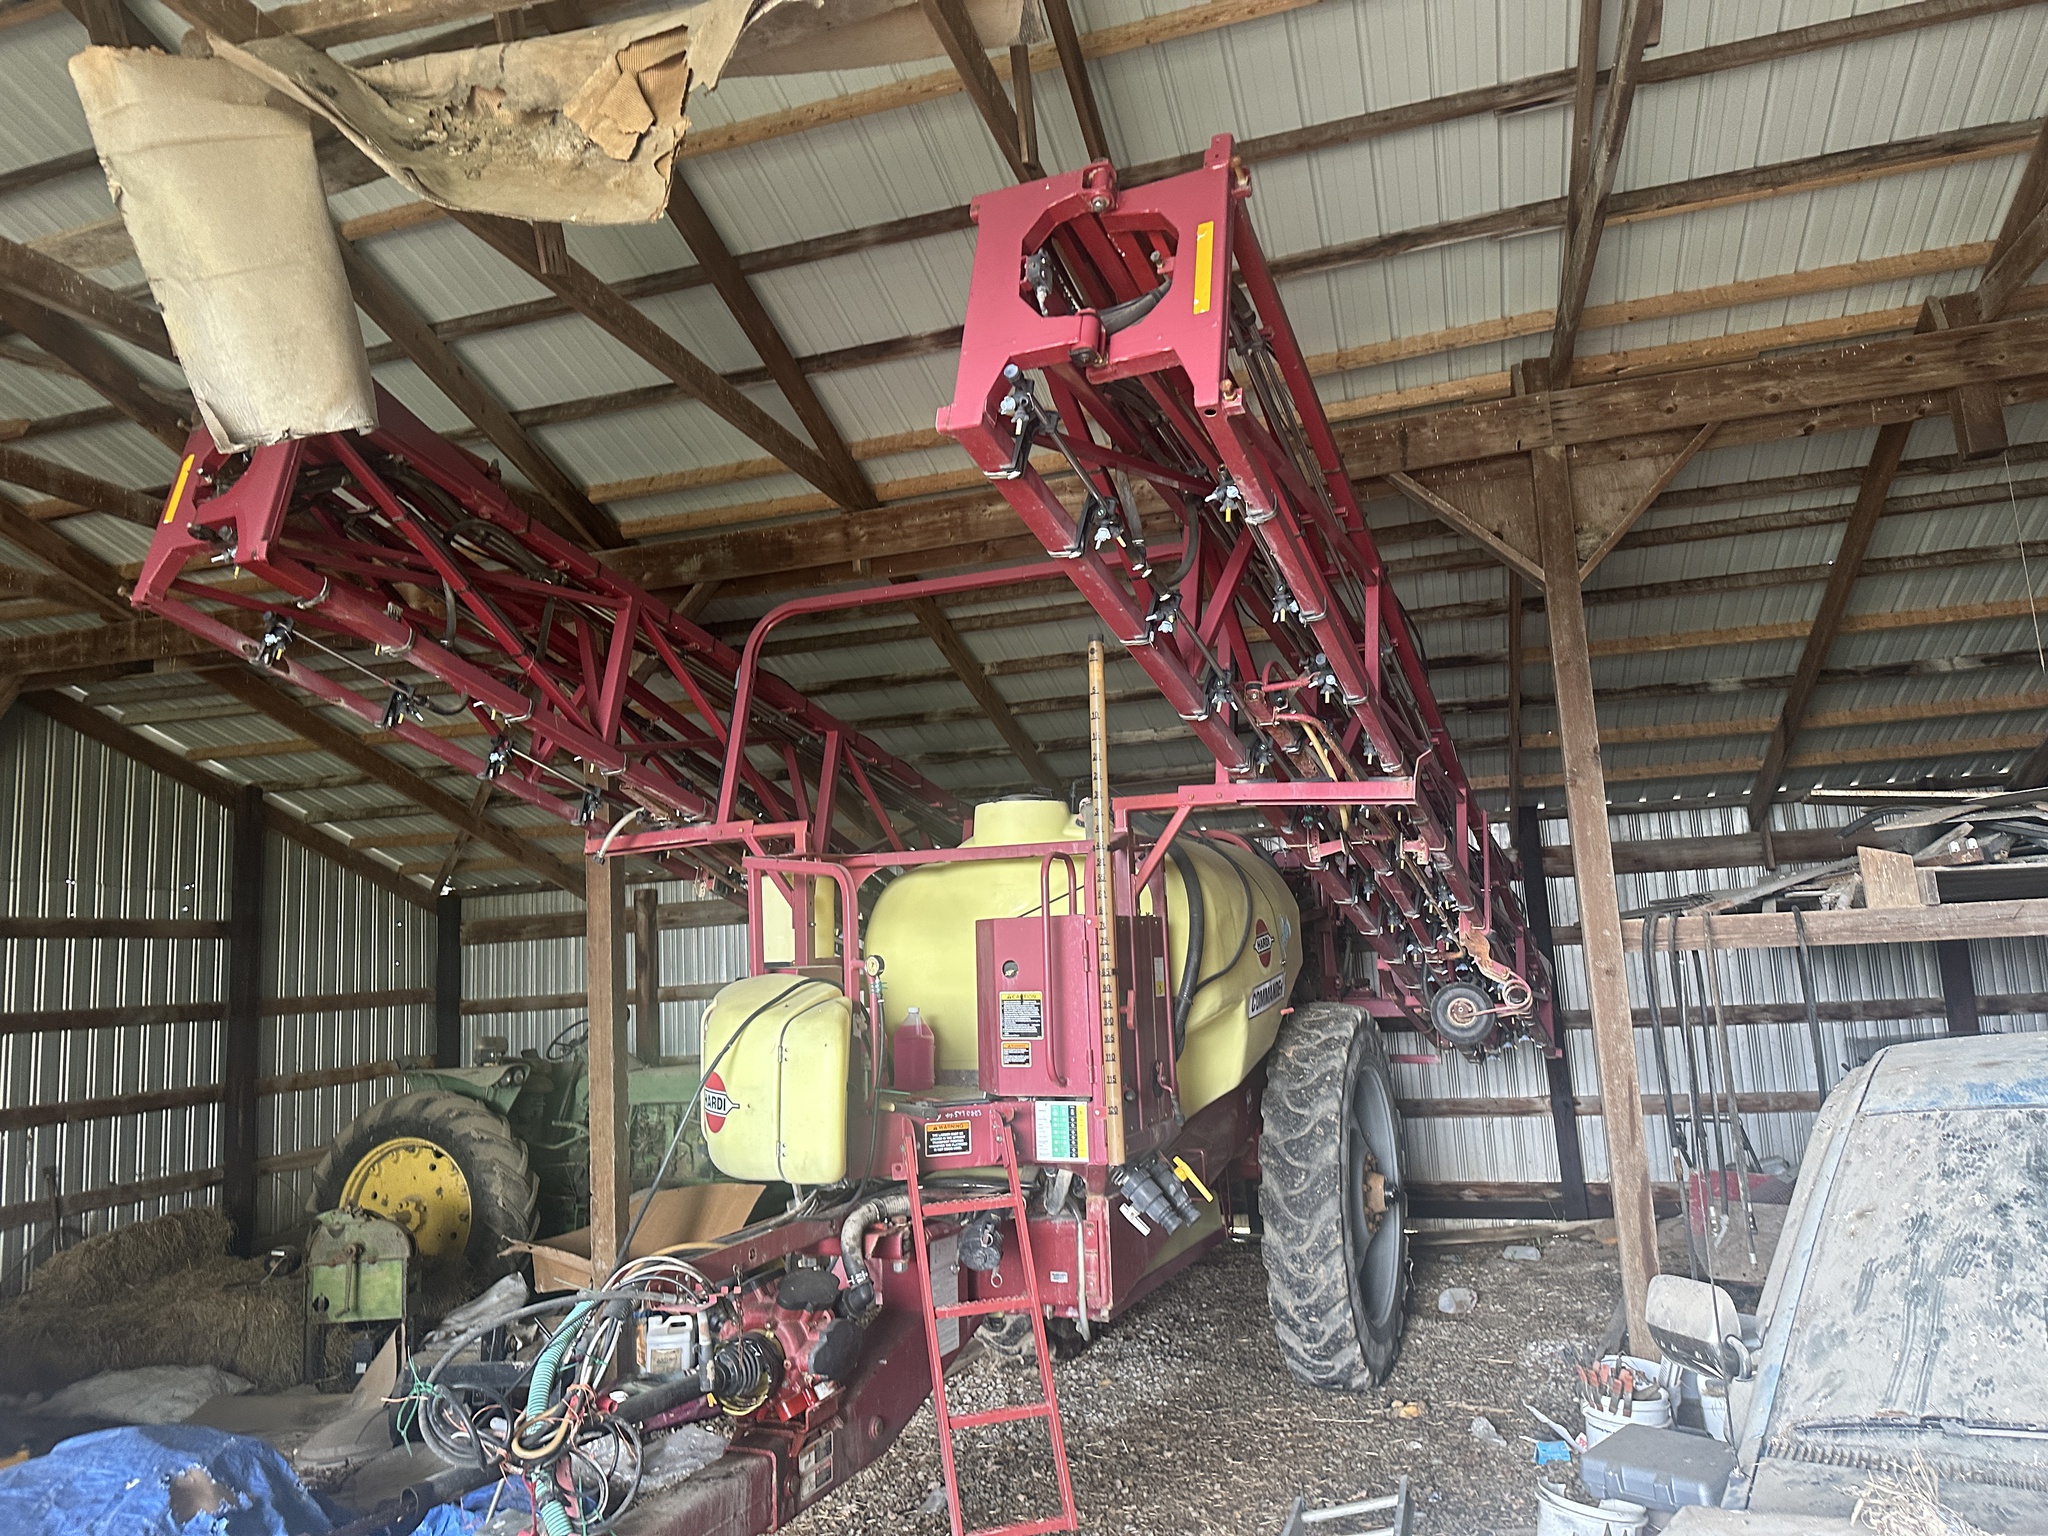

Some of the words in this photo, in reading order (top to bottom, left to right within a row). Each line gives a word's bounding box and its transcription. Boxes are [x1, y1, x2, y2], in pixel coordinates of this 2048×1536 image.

[1091, 711, 1100, 719] 10
[1100, 937, 1109, 945] 75
[1257, 936, 1271, 951] HARDI
[1103, 985, 1112, 993] 90
[1103, 1001, 1113, 1009] 95
[1104, 1017, 1114, 1026] 100
[1105, 1034, 1115, 1043] 105
[1105, 1053, 1116, 1061] 110
[1106, 1075, 1117, 1084] 115
[1108, 1106, 1118, 1115] 120
